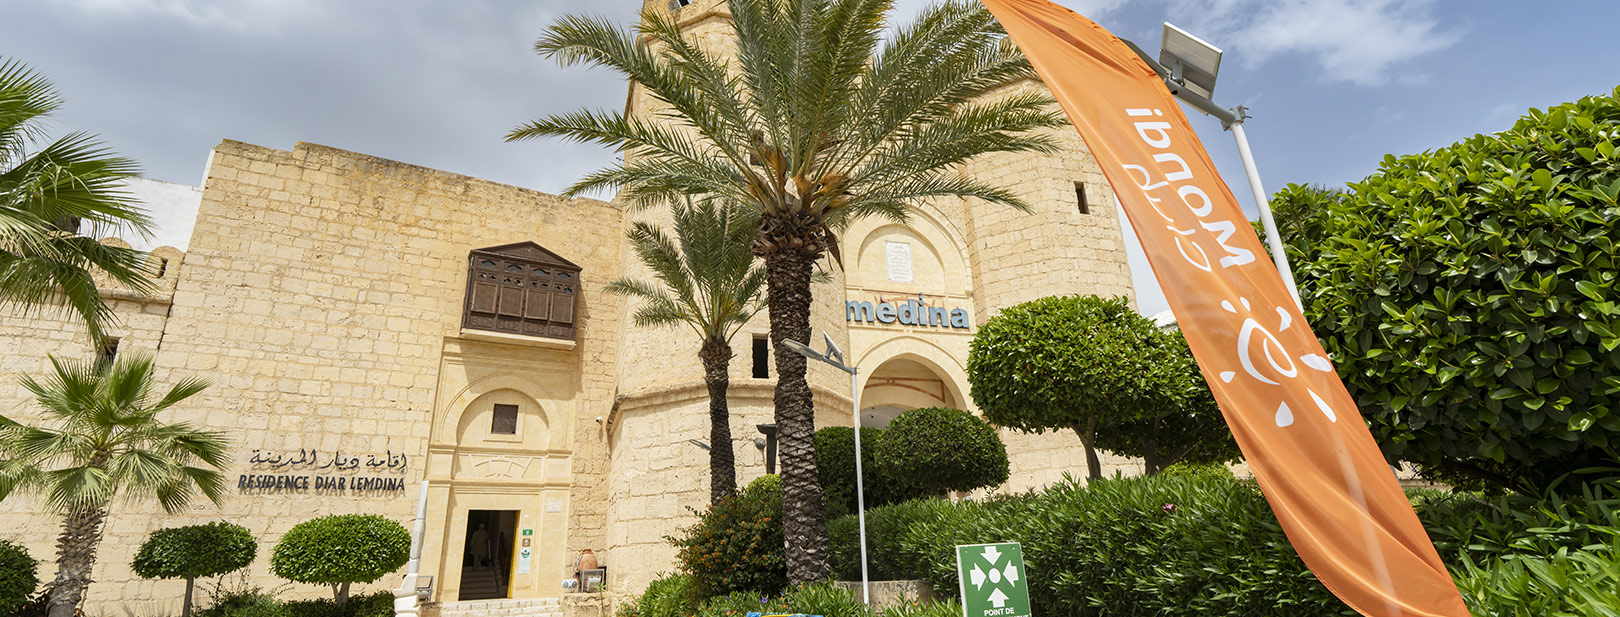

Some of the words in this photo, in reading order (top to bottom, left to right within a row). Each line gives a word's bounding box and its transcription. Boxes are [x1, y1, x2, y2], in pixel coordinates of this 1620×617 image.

[249, 448, 317, 468] المدينة
[319, 451, 359, 469] ديار
[366, 449, 407, 473] إقامة
[238, 474, 309, 489] RESIDENCE
[315, 476, 346, 490] DIAR
[350, 477, 405, 491] LEMDINA
[983, 608, 1004, 617] POINT
[1005, 607, 1015, 615] DE
